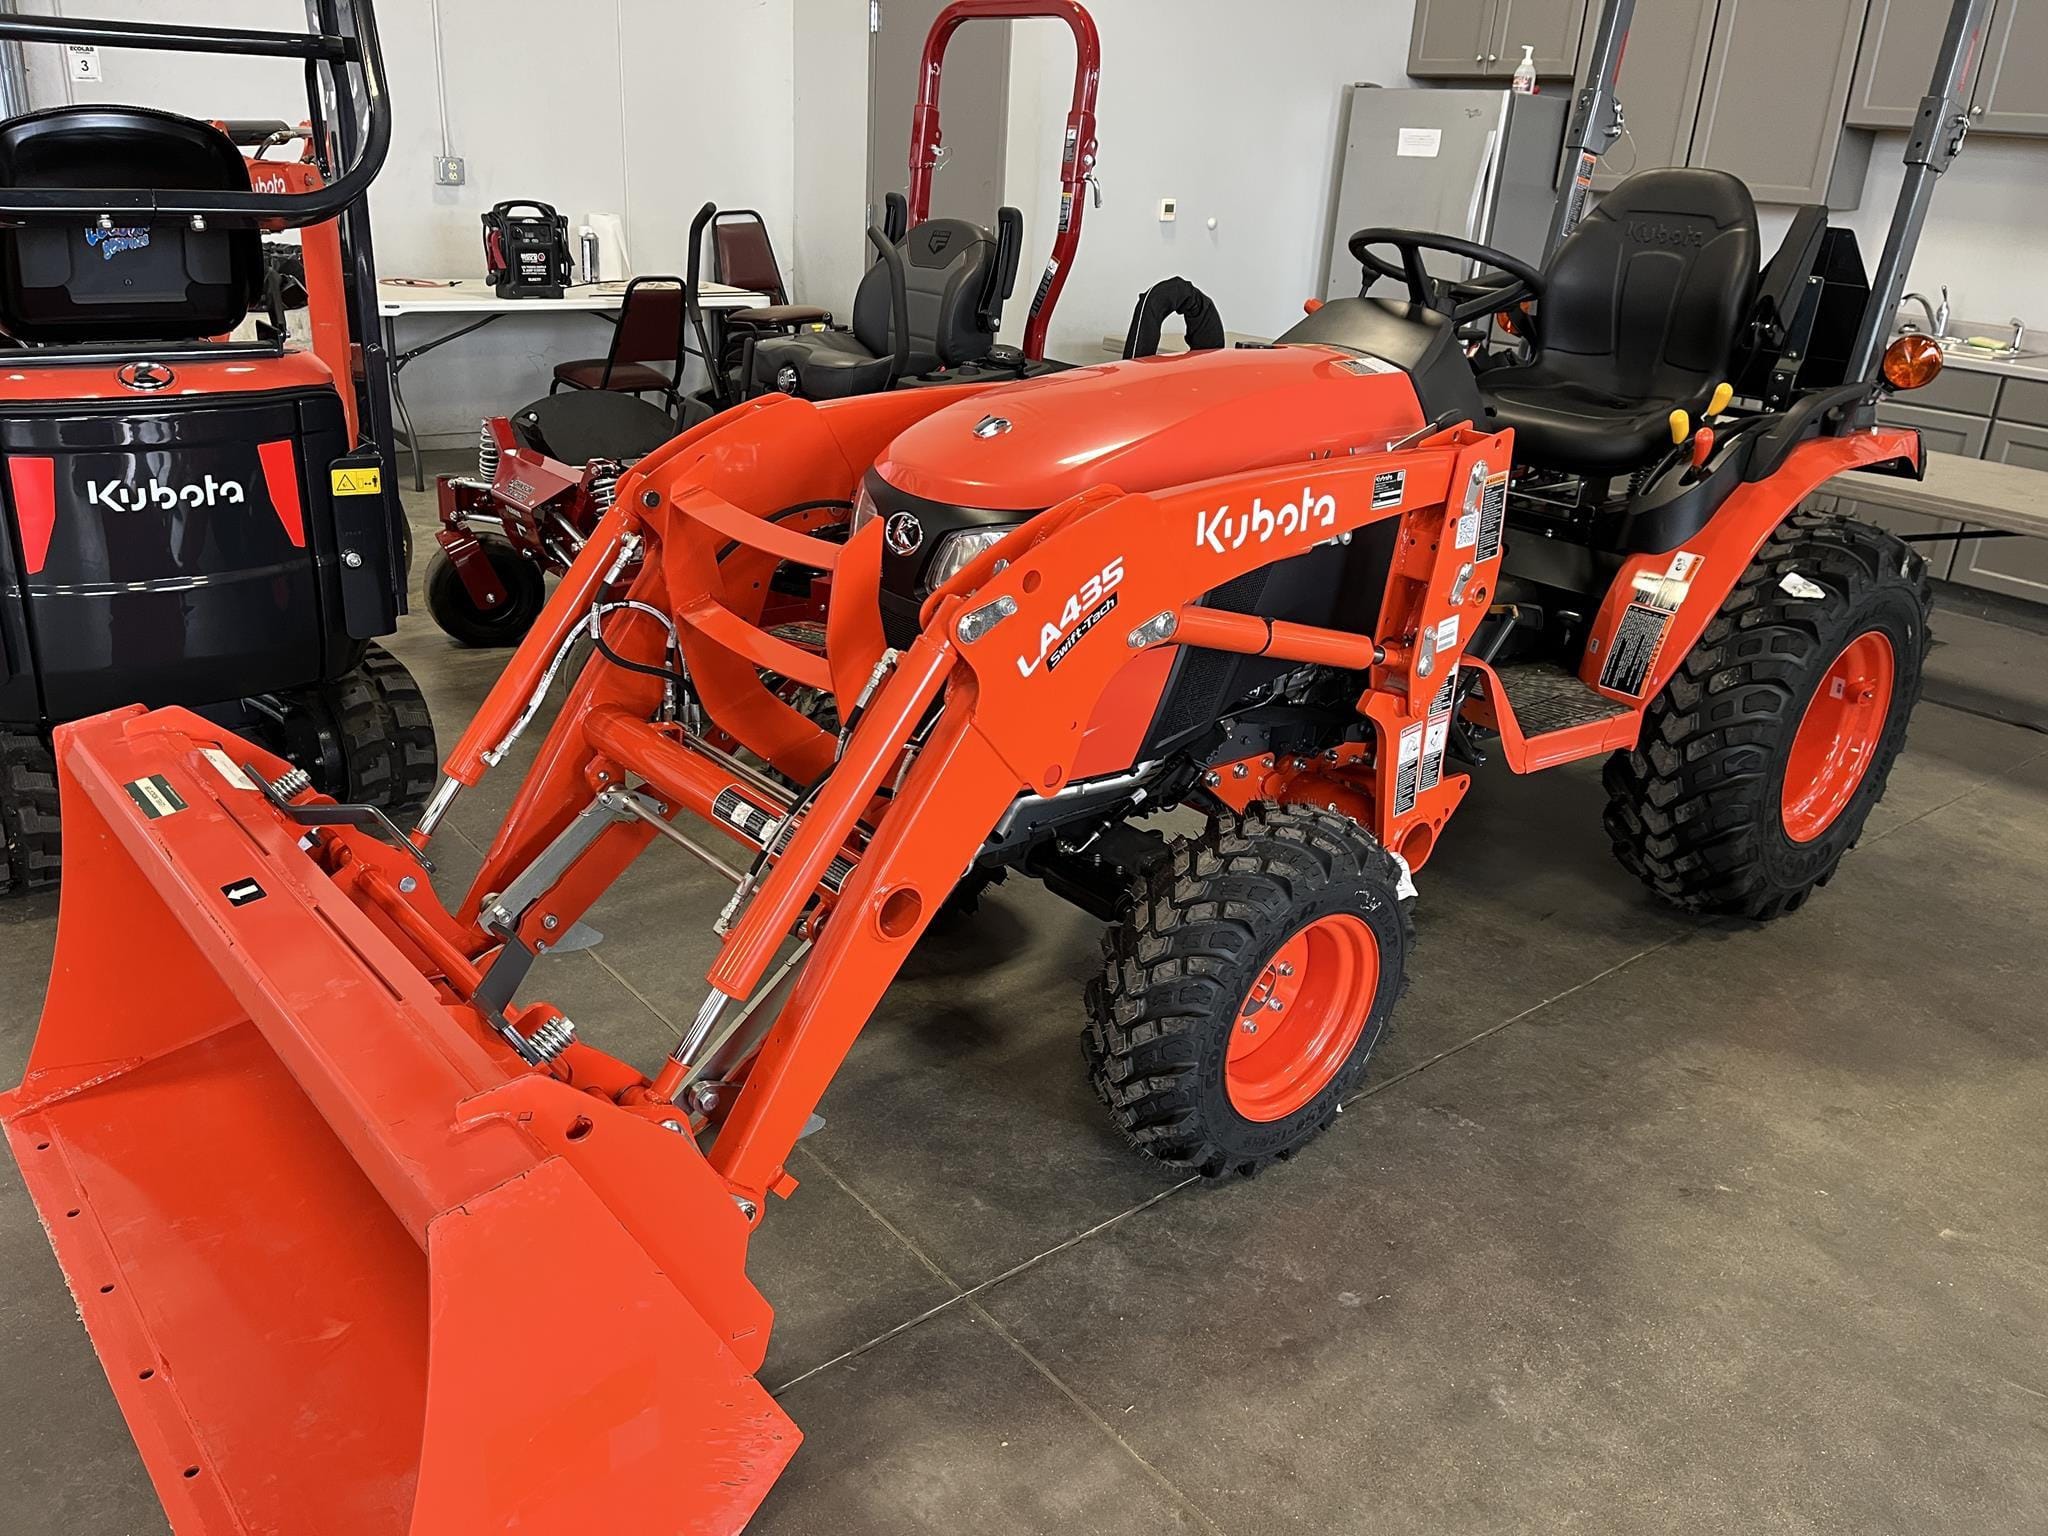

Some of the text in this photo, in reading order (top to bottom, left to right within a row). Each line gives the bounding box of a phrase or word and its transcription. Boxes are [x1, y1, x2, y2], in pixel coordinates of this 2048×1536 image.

[81, 60, 89, 71] 3
[251, 173, 286, 193] ubota
[1625, 221, 1703, 248] Kubota
[87, 474, 244, 512] Kubota
[1196, 487, 1336, 553] Kubota
[1017, 556, 1124, 677] LA435
[1050, 597, 1116, 668] Swift-Tach
